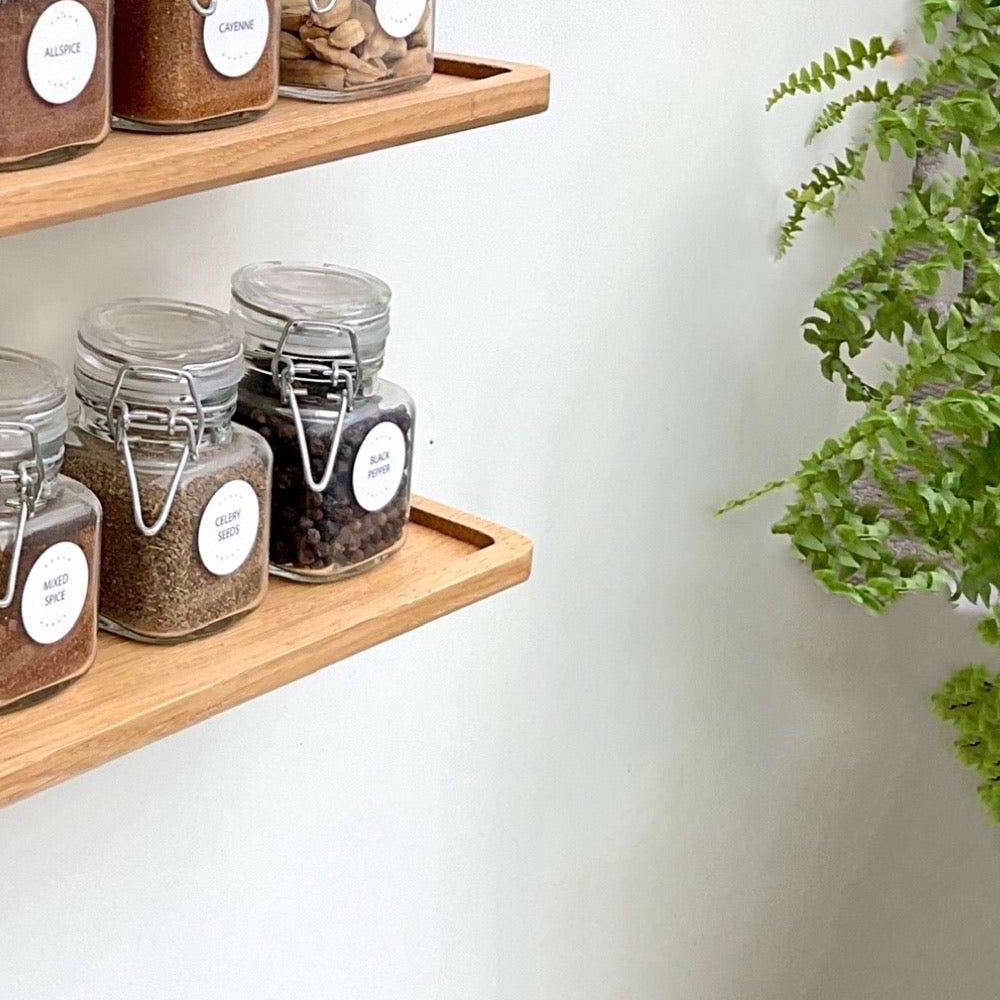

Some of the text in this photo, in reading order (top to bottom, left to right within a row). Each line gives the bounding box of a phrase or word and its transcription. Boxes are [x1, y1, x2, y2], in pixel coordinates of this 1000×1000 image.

[218, 19, 254, 33] CAYENNE
[45, 42, 81, 58] ALLSPICE
[370, 451, 390, 466] BLACK
[368, 463, 391, 479] PEPPER
[215, 509, 241, 528] CELERY
[217, 524, 240, 541] SEEDS
[43, 573, 69, 592] MIXED
[45, 589, 66, 606] SPICE
